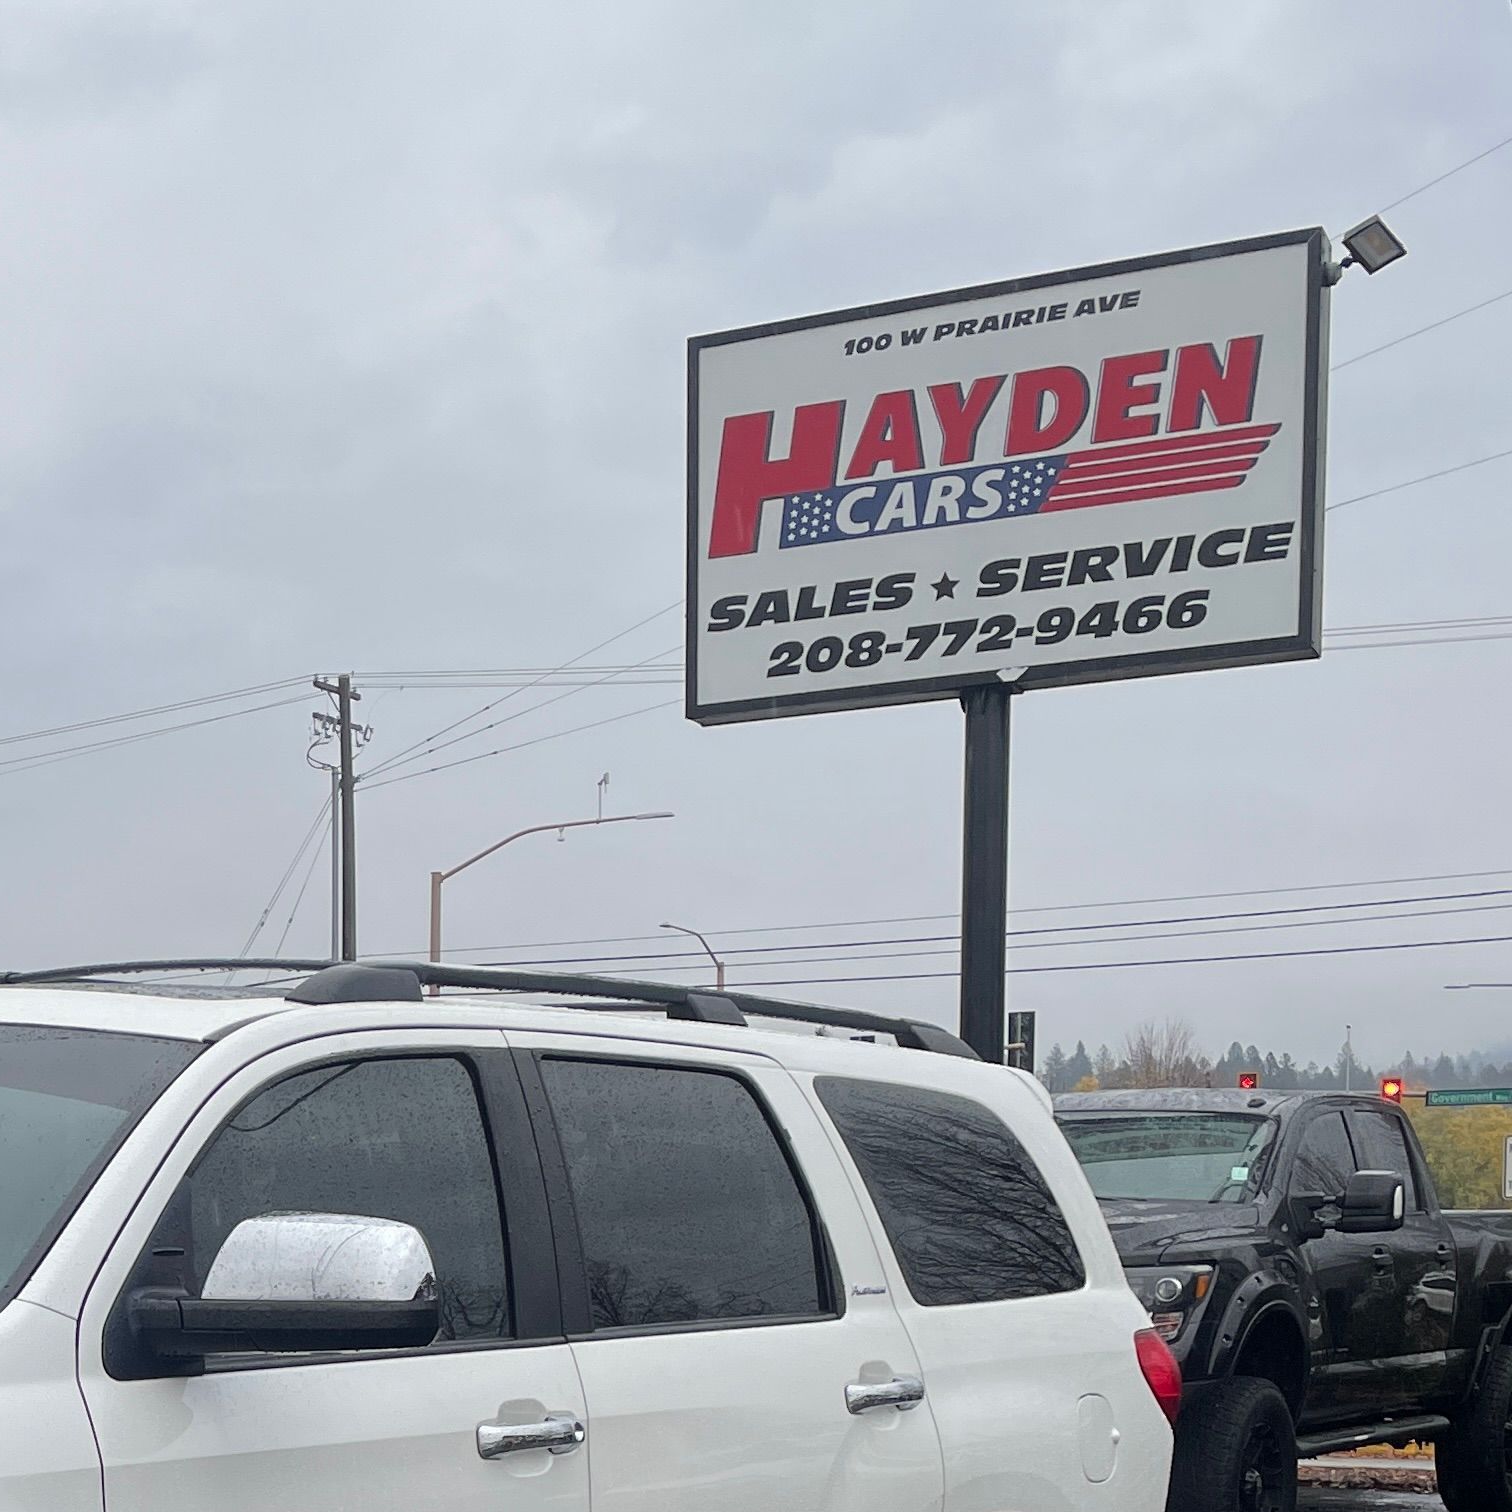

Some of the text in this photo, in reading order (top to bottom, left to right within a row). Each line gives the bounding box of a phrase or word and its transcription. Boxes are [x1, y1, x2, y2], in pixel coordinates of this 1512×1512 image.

[843, 290, 1141, 355] 100 W PRAIRIE AVE
[708, 334, 1263, 559] HAYDEN
[834, 467, 1006, 536] CARS
[707, 521, 1295, 632] SALES SERVICE
[767, 590, 1210, 678] 208-772-9466
